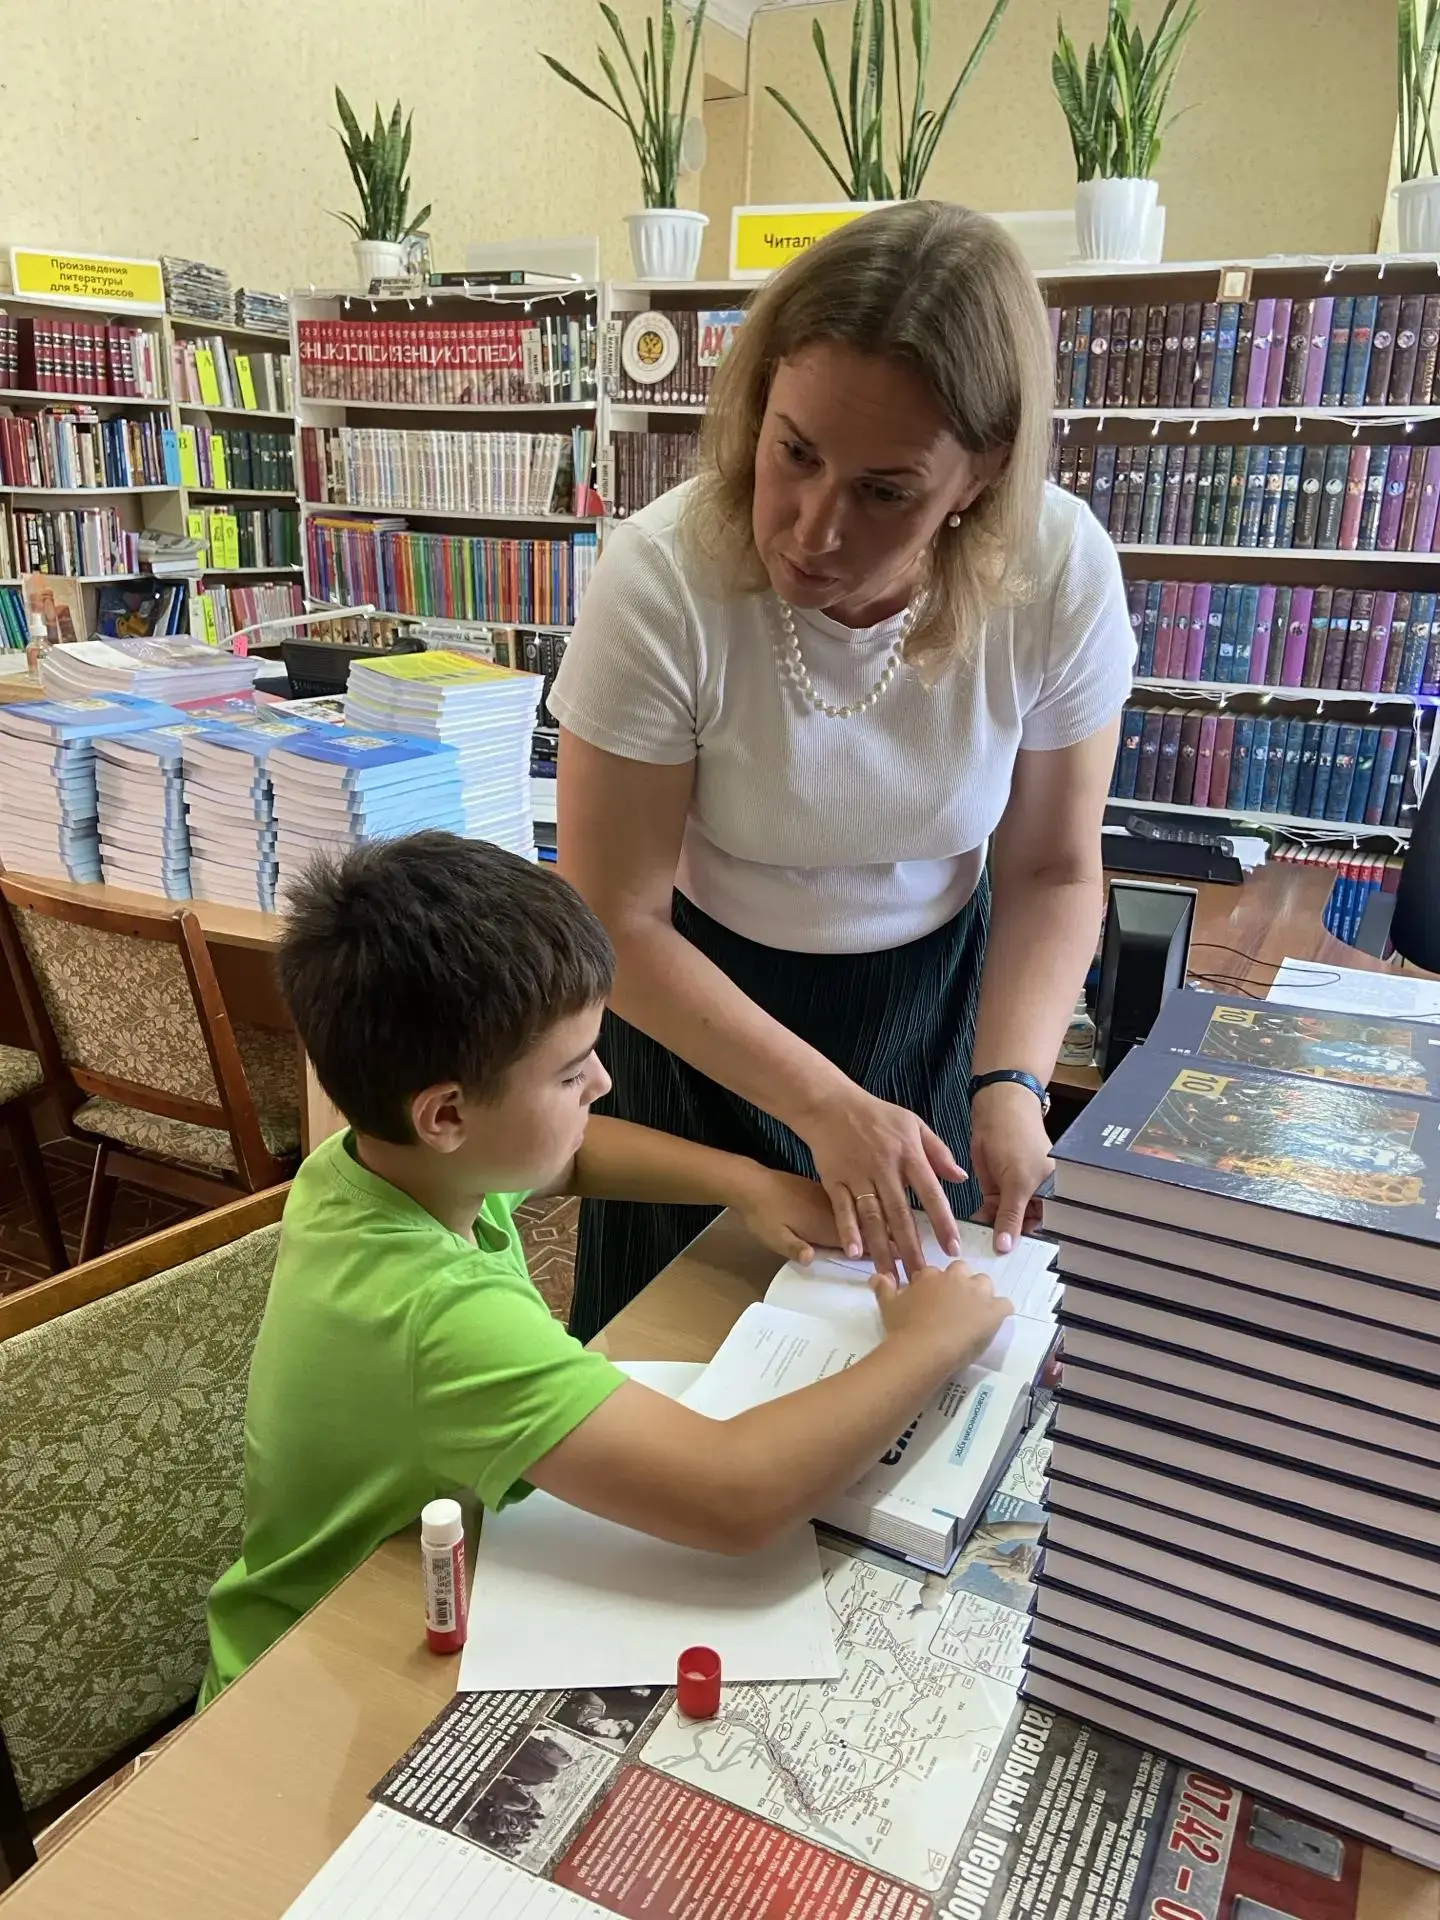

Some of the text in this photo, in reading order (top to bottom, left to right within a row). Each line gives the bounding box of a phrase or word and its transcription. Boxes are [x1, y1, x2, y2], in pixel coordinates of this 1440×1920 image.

[51, 259, 128, 274] Произведения
[60, 273, 123, 285] литературы
[50, 284, 134, 298] для 5-7 классов
[1219, 1009, 1249, 1022] 10
[1182, 1075, 1219, 1092] 10
[955, 1391, 989, 1458] Классический курс
[508, 1696, 529, 1715] войск
[455, 1715, 473, 1730] 1943
[470, 1724, 491, 1744] стали
[495, 1715, 512, 1729] под
[505, 1724, 518, 1734] но
[382, 1702, 469, 1796] из пределов нашей страны.
[403, 1706, 492, 1807] успешного контрнаступления
[413, 1737, 452, 1777] развернула
[443, 1745, 473, 1776] главным
[454, 1729, 502, 1780] Сталинградом
[476, 1741, 504, 1770] весомое
[393, 1777, 419, 1802] общее
[413, 1777, 446, 1812] перелом-
[428, 1780, 458, 1811] привели
[434, 1771, 480, 1822] политическое
[619, 1800, 634, 1815] 2500
[1013, 1755, 1065, 1876] ПОМОГЛО НАМ ПОБЕДИТЬ В ЭТОЙ
[1017, 1730, 1088, 1910] РАЗДУМЫВАЯ, ОТДАТЬ СВОЮ ЖИЗНЬ ЗА РОДИНУ
[1141, 1793, 1156, 1818] БИТВА
[1168, 1772, 1235, 1866] 07.42
[1034, 1749, 1097, 1911] БЕЗЗАВЕТНАЯ ЛЮБОВЬ К РОДНОЙ ЗЕМЛЕ И
[1060, 1787, 1106, 1899] ЭТО БЕСПРИМЕРНЫЙ ПОДВИГ
[1101, 1788, 1142, 1896] СУММАРНЫЕ ПОТЕРИ ОБЕИХ
[1129, 1829, 1147, 1857] САМОЕ
[1085, 1821, 1117, 1891] ПРЕВЫШАЮТ ДВА
[575, 1864, 591, 1878] 100
[729, 1873, 742, 1888] 150
[1117, 1857, 1139, 1901] ЖЕСТОКОЕ
[875, 1880, 890, 1894] 23
